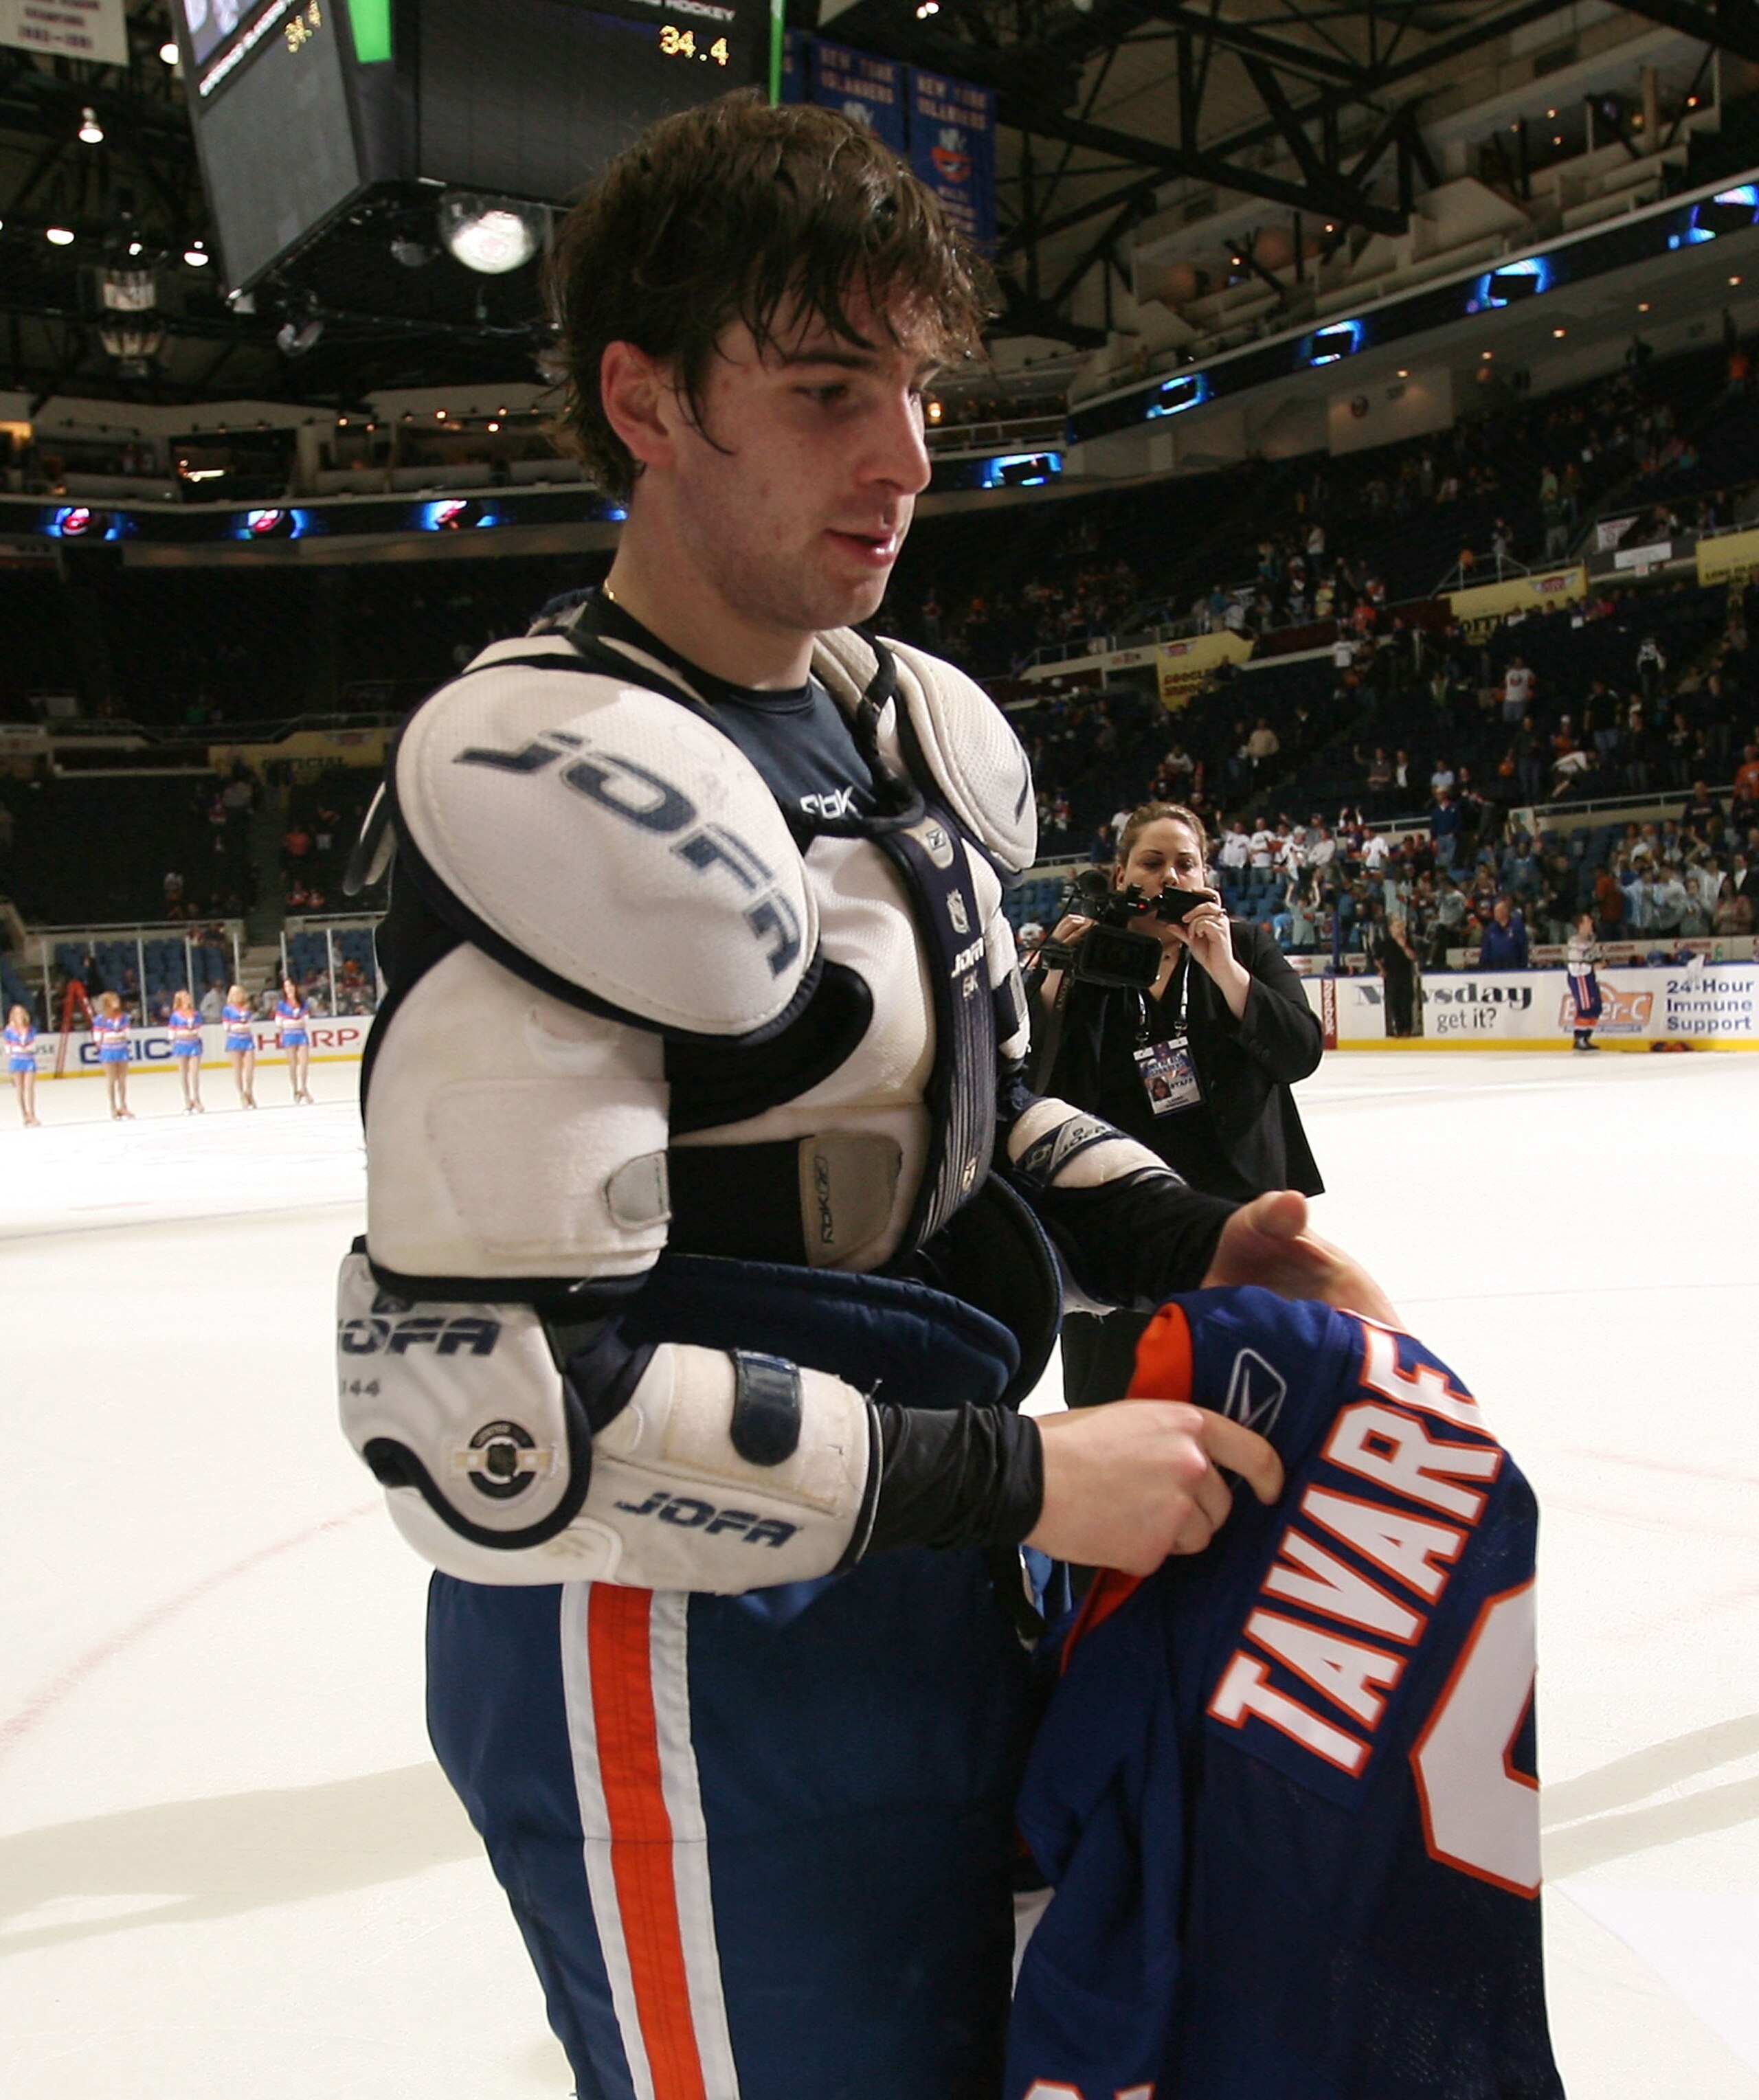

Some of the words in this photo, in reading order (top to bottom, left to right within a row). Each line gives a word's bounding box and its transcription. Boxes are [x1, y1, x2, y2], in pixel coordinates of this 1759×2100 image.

[659, 25, 730, 66] 34.4
[451, 730, 802, 980] JOFA
[1666, 978, 1754, 994] 24-Hour
[1437, 1012, 1467, 1033] get
[1473, 1007, 1497, 1028] it?
[1666, 998, 1753, 1013] Immune
[1666, 1017, 1751, 1036] Support
[337, 1317, 503, 1355] OFA
[613, 1491, 798, 1549] JOFA
[1208, 1309, 1502, 1780] TAVARE
